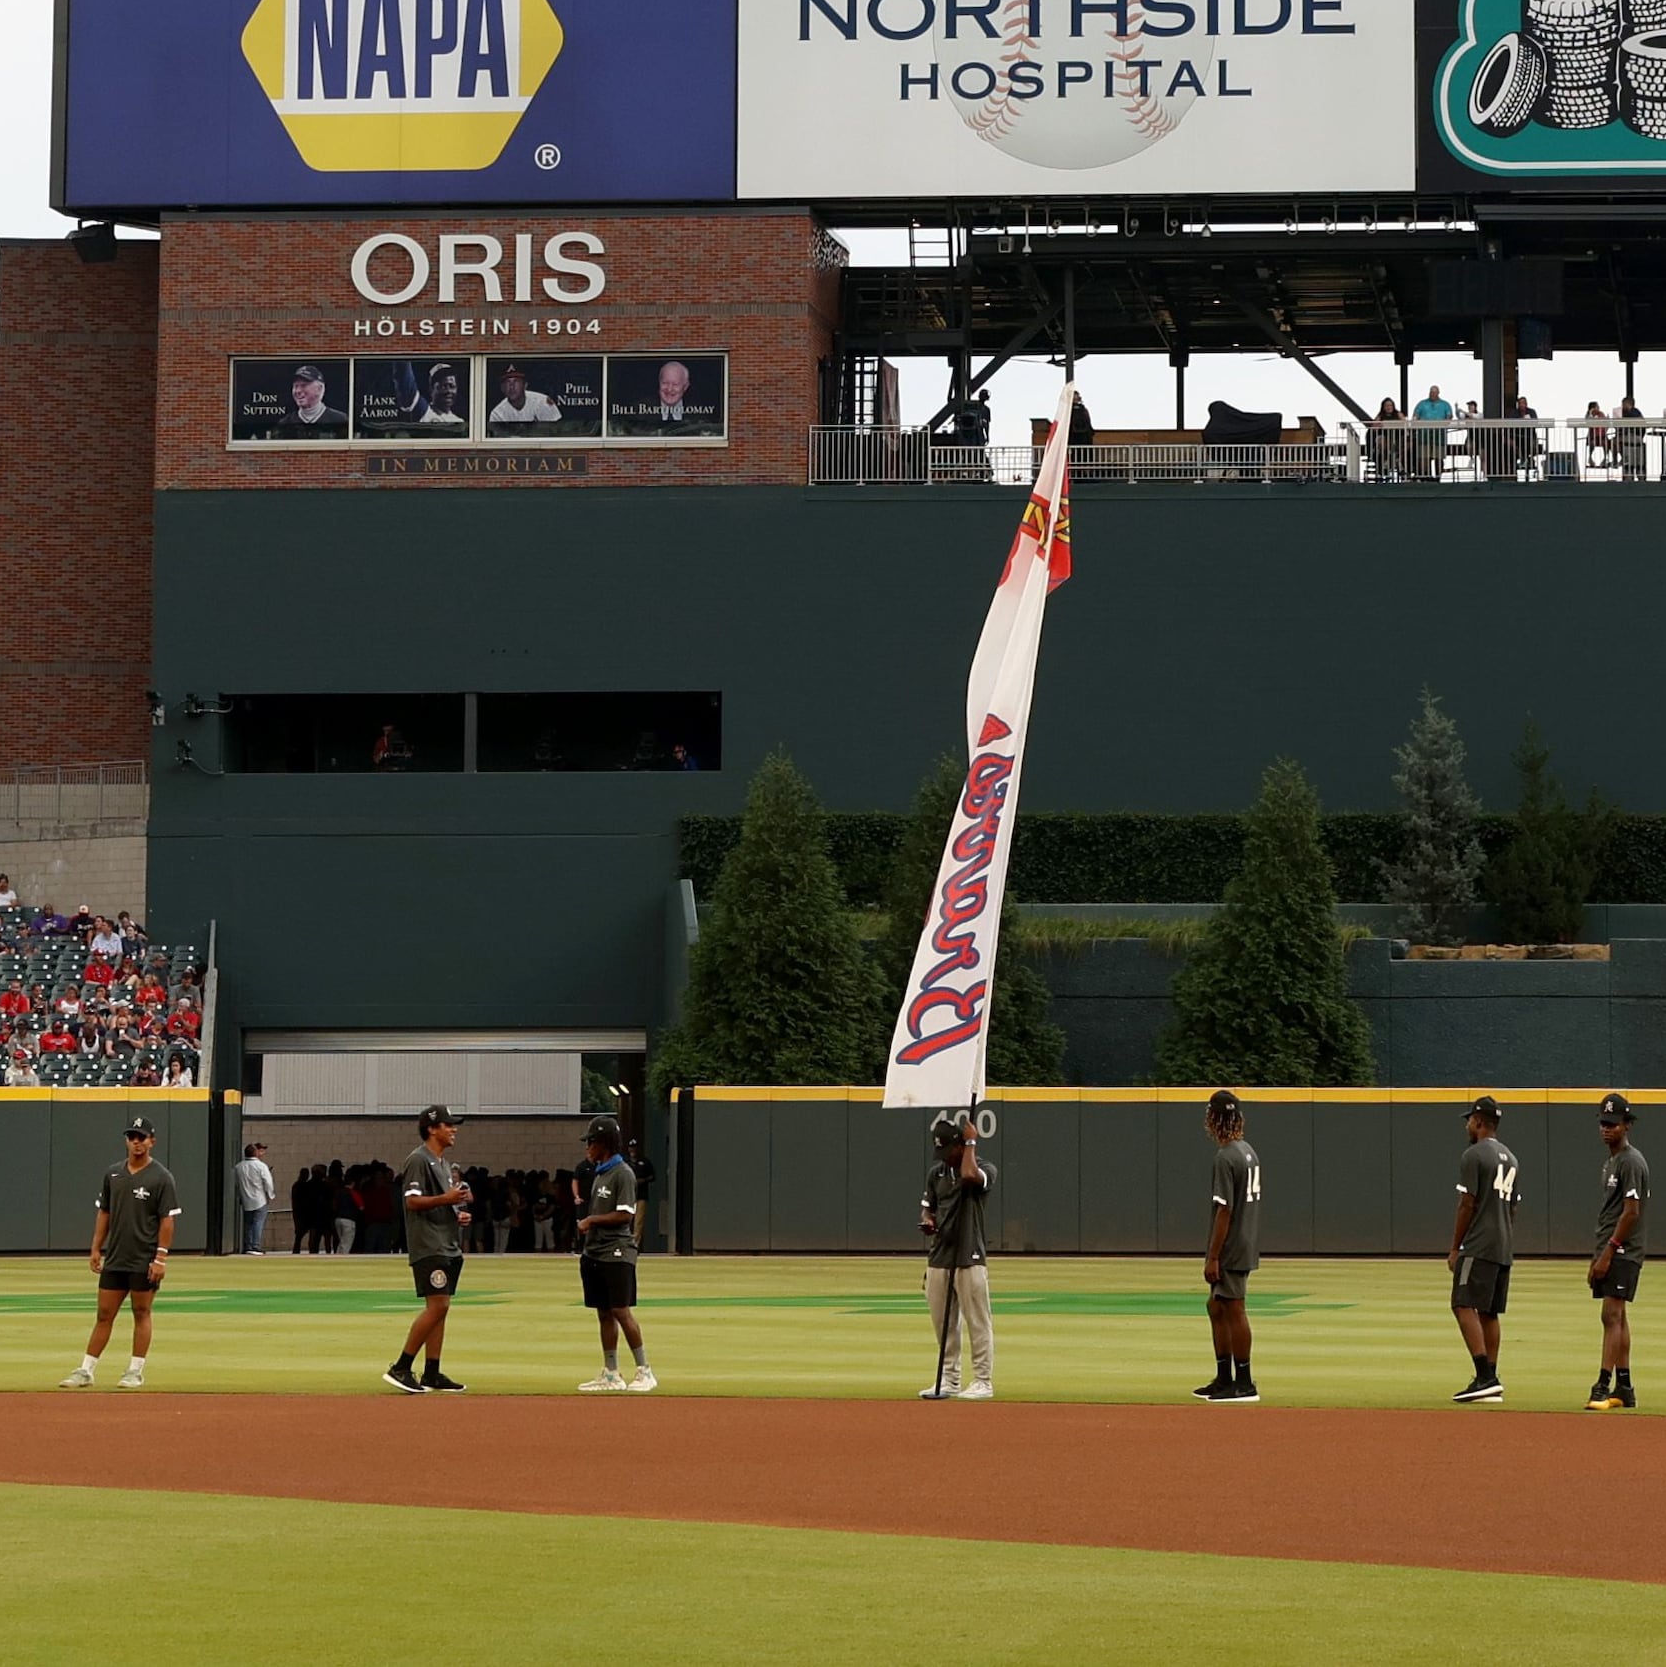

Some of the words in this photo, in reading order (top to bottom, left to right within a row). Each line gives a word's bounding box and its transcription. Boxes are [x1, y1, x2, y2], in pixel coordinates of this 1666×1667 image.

[899, 59, 1253, 101] HOSPITAL
[350, 230, 607, 306] ORIS
[354, 315, 512, 336] HÖLSTEIN
[528, 318, 603, 336] 1904
[380, 458, 407, 473] IN
[427, 457, 576, 472] MEMORIAM
